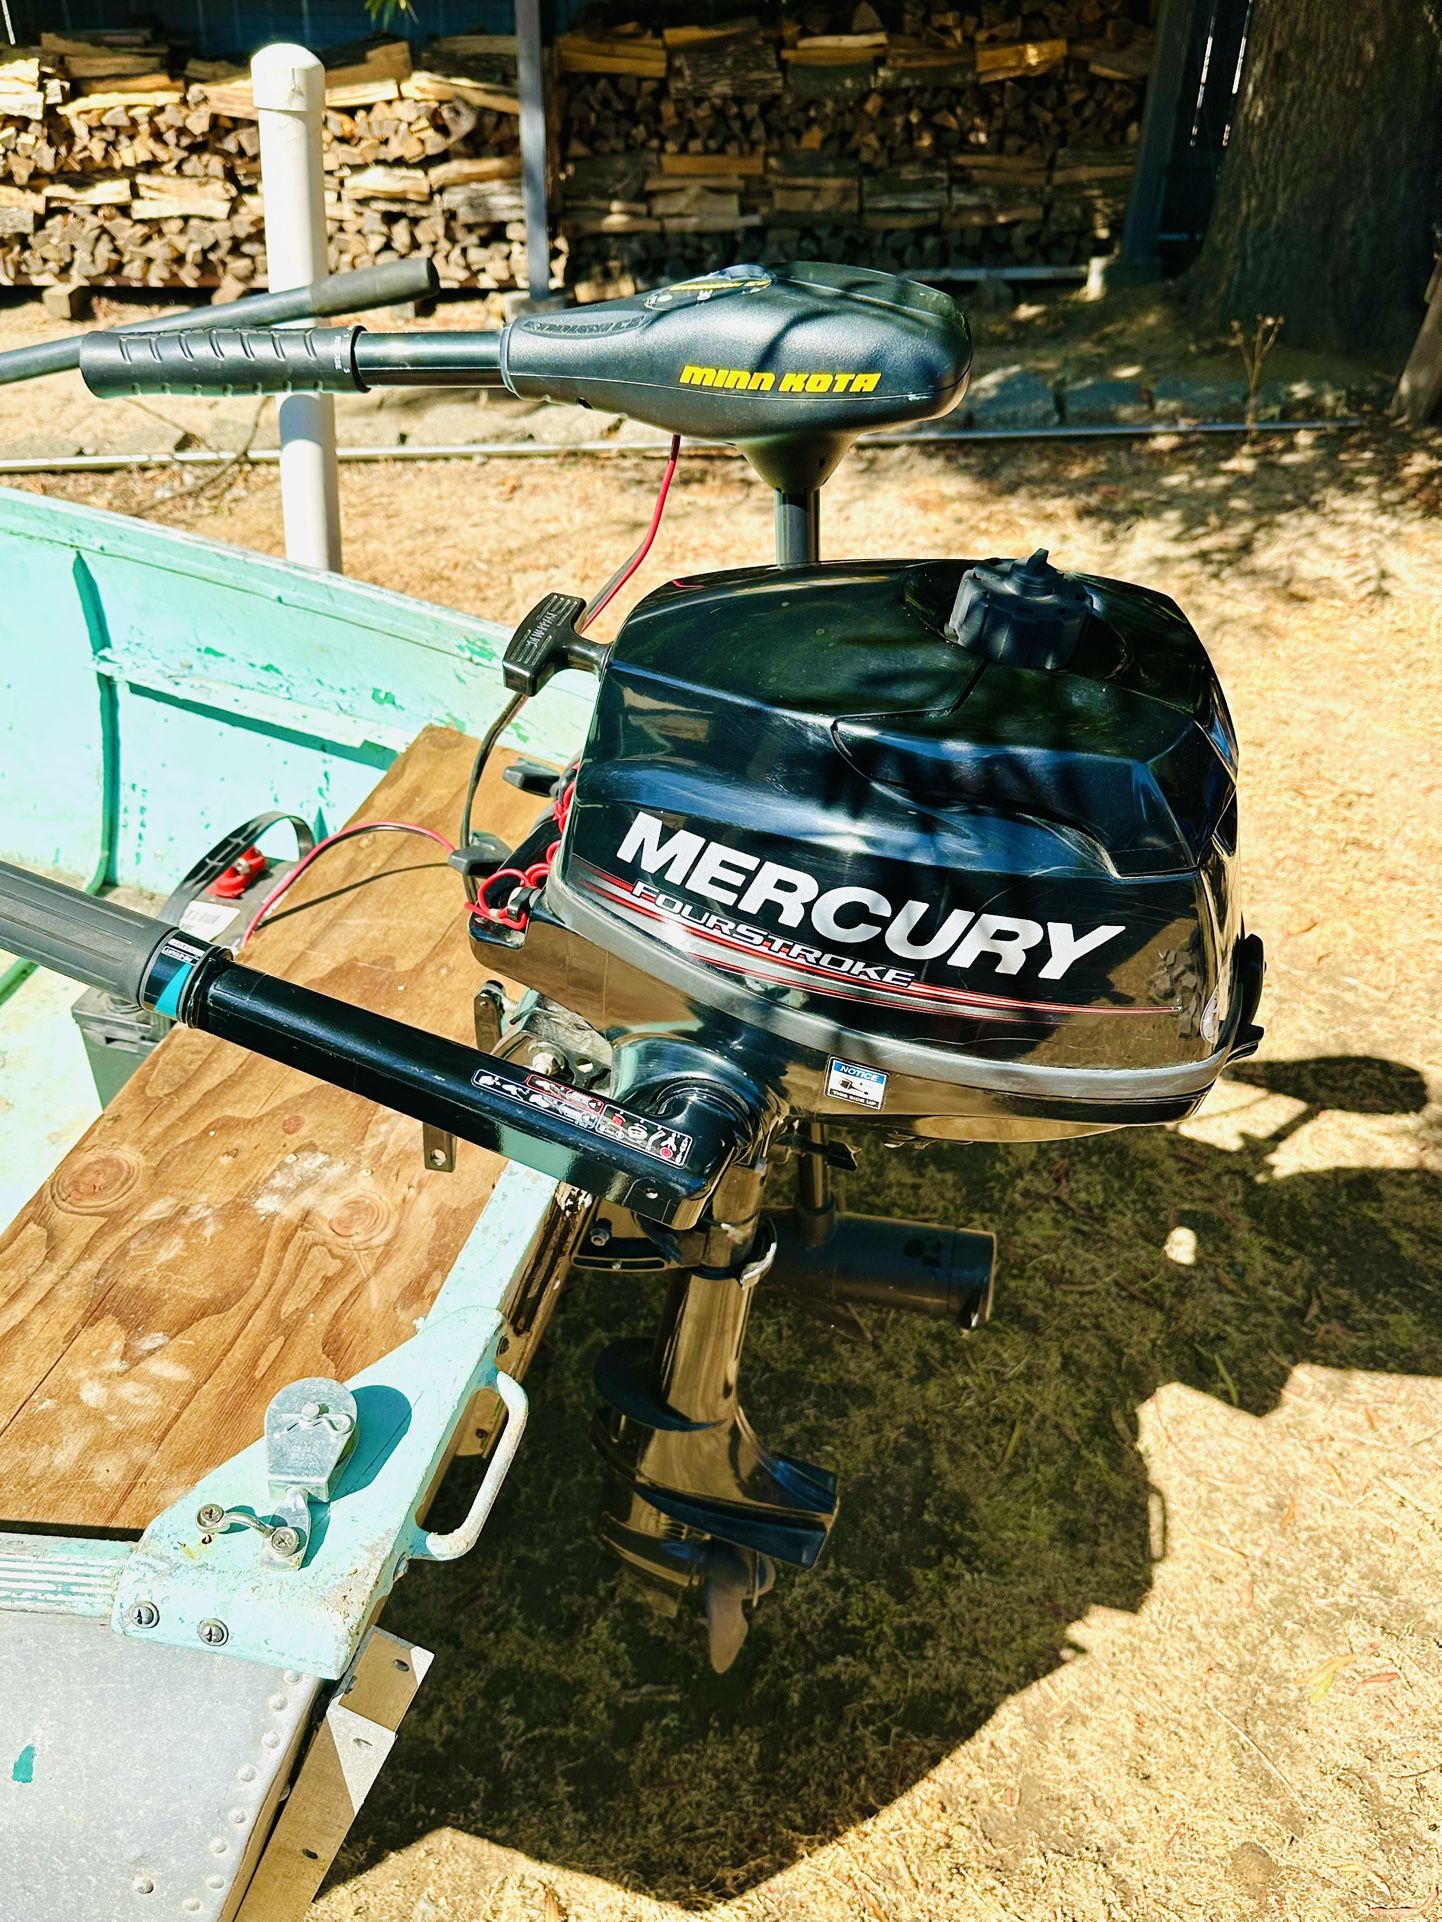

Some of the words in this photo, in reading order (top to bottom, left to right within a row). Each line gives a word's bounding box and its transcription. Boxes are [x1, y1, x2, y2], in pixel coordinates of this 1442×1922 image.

[679, 365, 776, 391] MINN
[778, 372, 882, 393] KOTA
[616, 811, 1126, 980] MERCURY
[632, 881, 915, 988] FOURSTROKE
[839, 1065, 880, 1082] NOTICE
